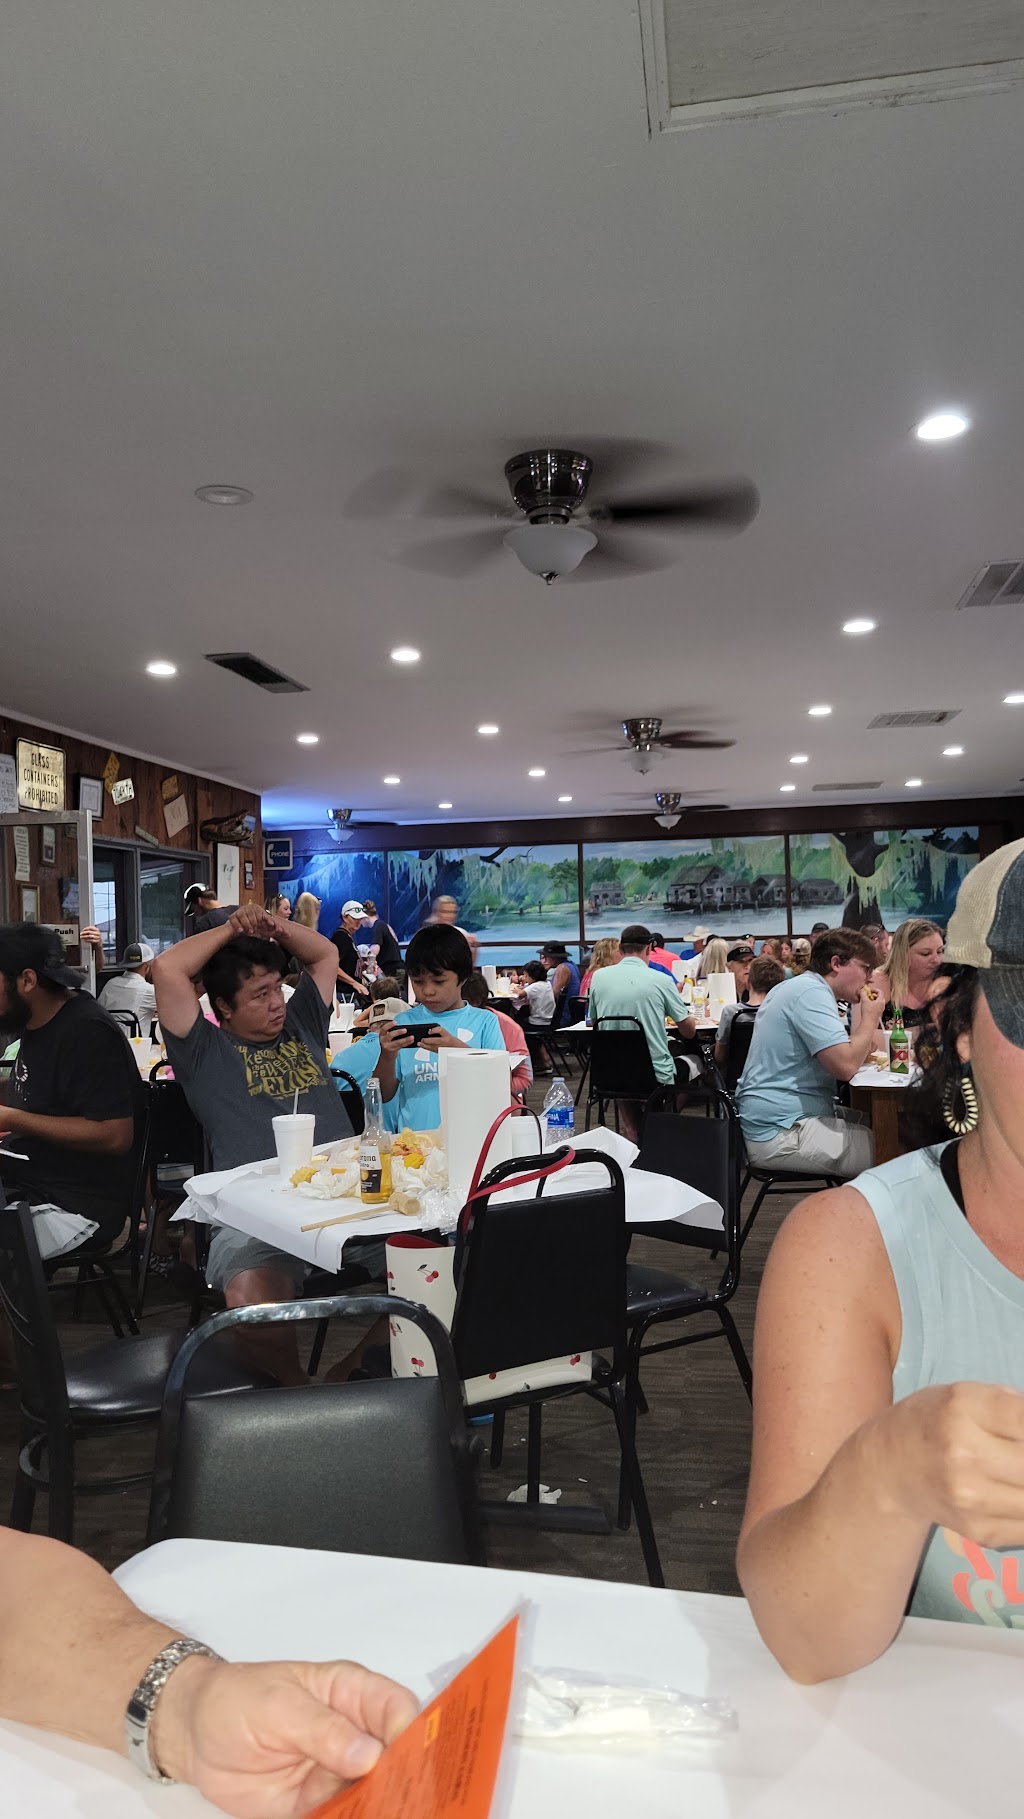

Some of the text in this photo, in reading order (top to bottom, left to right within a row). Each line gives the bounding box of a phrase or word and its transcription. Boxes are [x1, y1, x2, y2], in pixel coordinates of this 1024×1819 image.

[31, 753, 50, 769] GLASS
[23, 768, 59, 788] CONTAINERS
[24, 787, 59, 805] PROHIBITED
